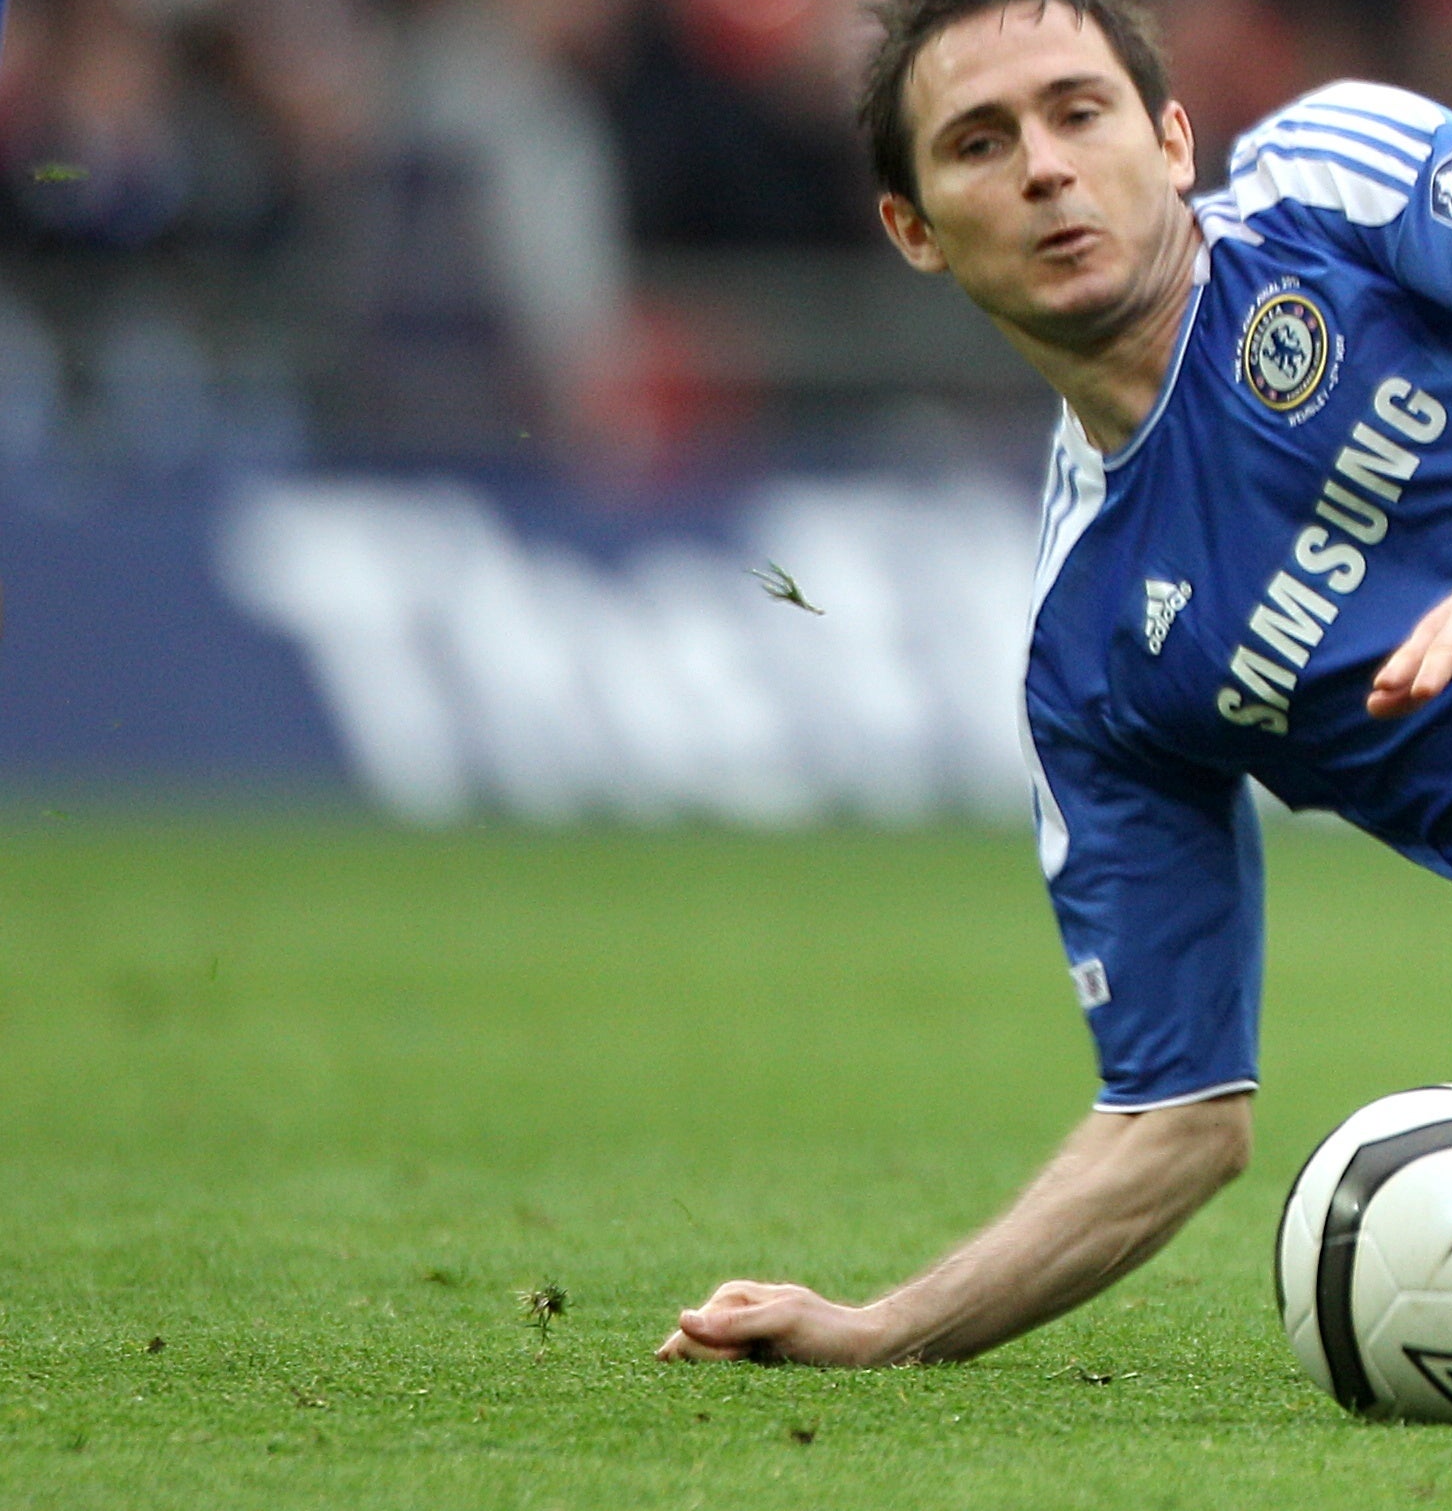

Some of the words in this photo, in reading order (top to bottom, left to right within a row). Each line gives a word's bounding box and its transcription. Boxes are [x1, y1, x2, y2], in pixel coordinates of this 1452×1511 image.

[1250, 304, 1283, 366] CHELSEA
[1217, 376, 1447, 736] SAMSUNG
[1148, 579, 1193, 656] adidas
